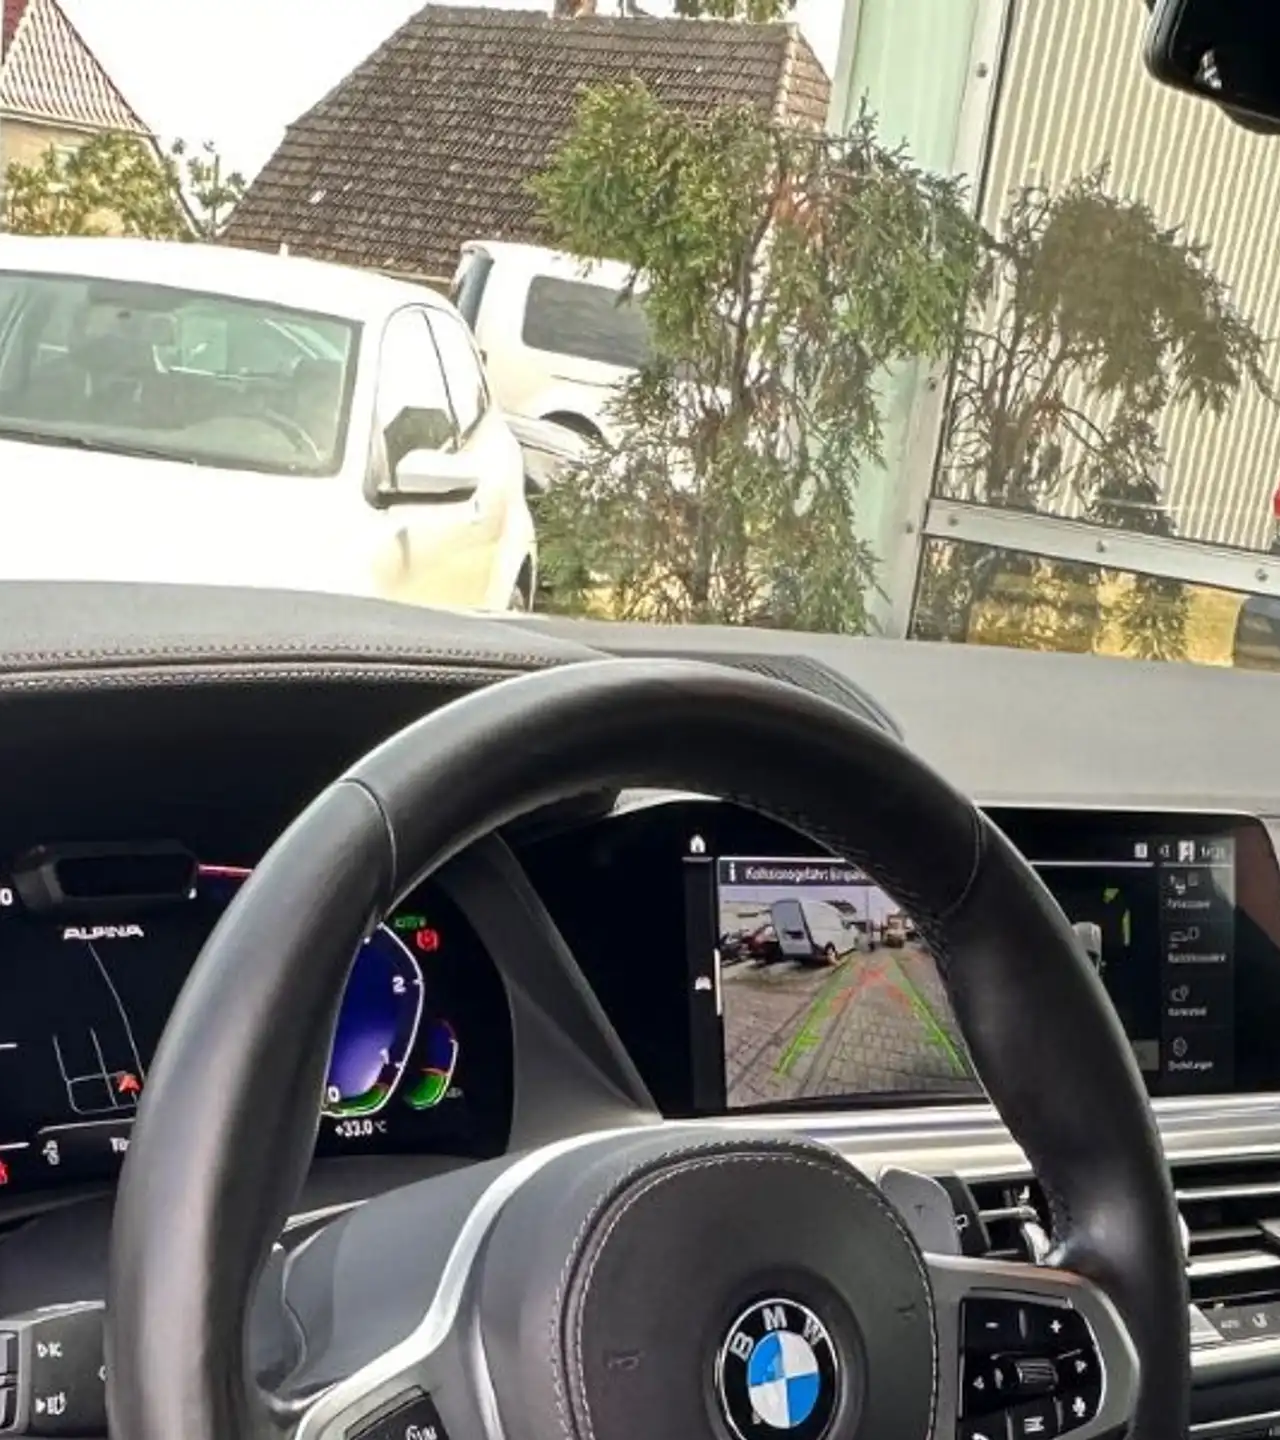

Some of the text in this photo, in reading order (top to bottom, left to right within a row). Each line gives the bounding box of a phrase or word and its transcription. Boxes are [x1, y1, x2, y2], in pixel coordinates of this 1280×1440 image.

[63, 924, 145, 940] ALPINA
[392, 975, 407, 994] 2
[326, 1086, 341, 1104] 0
[729, 1305, 825, 1362] BMW
